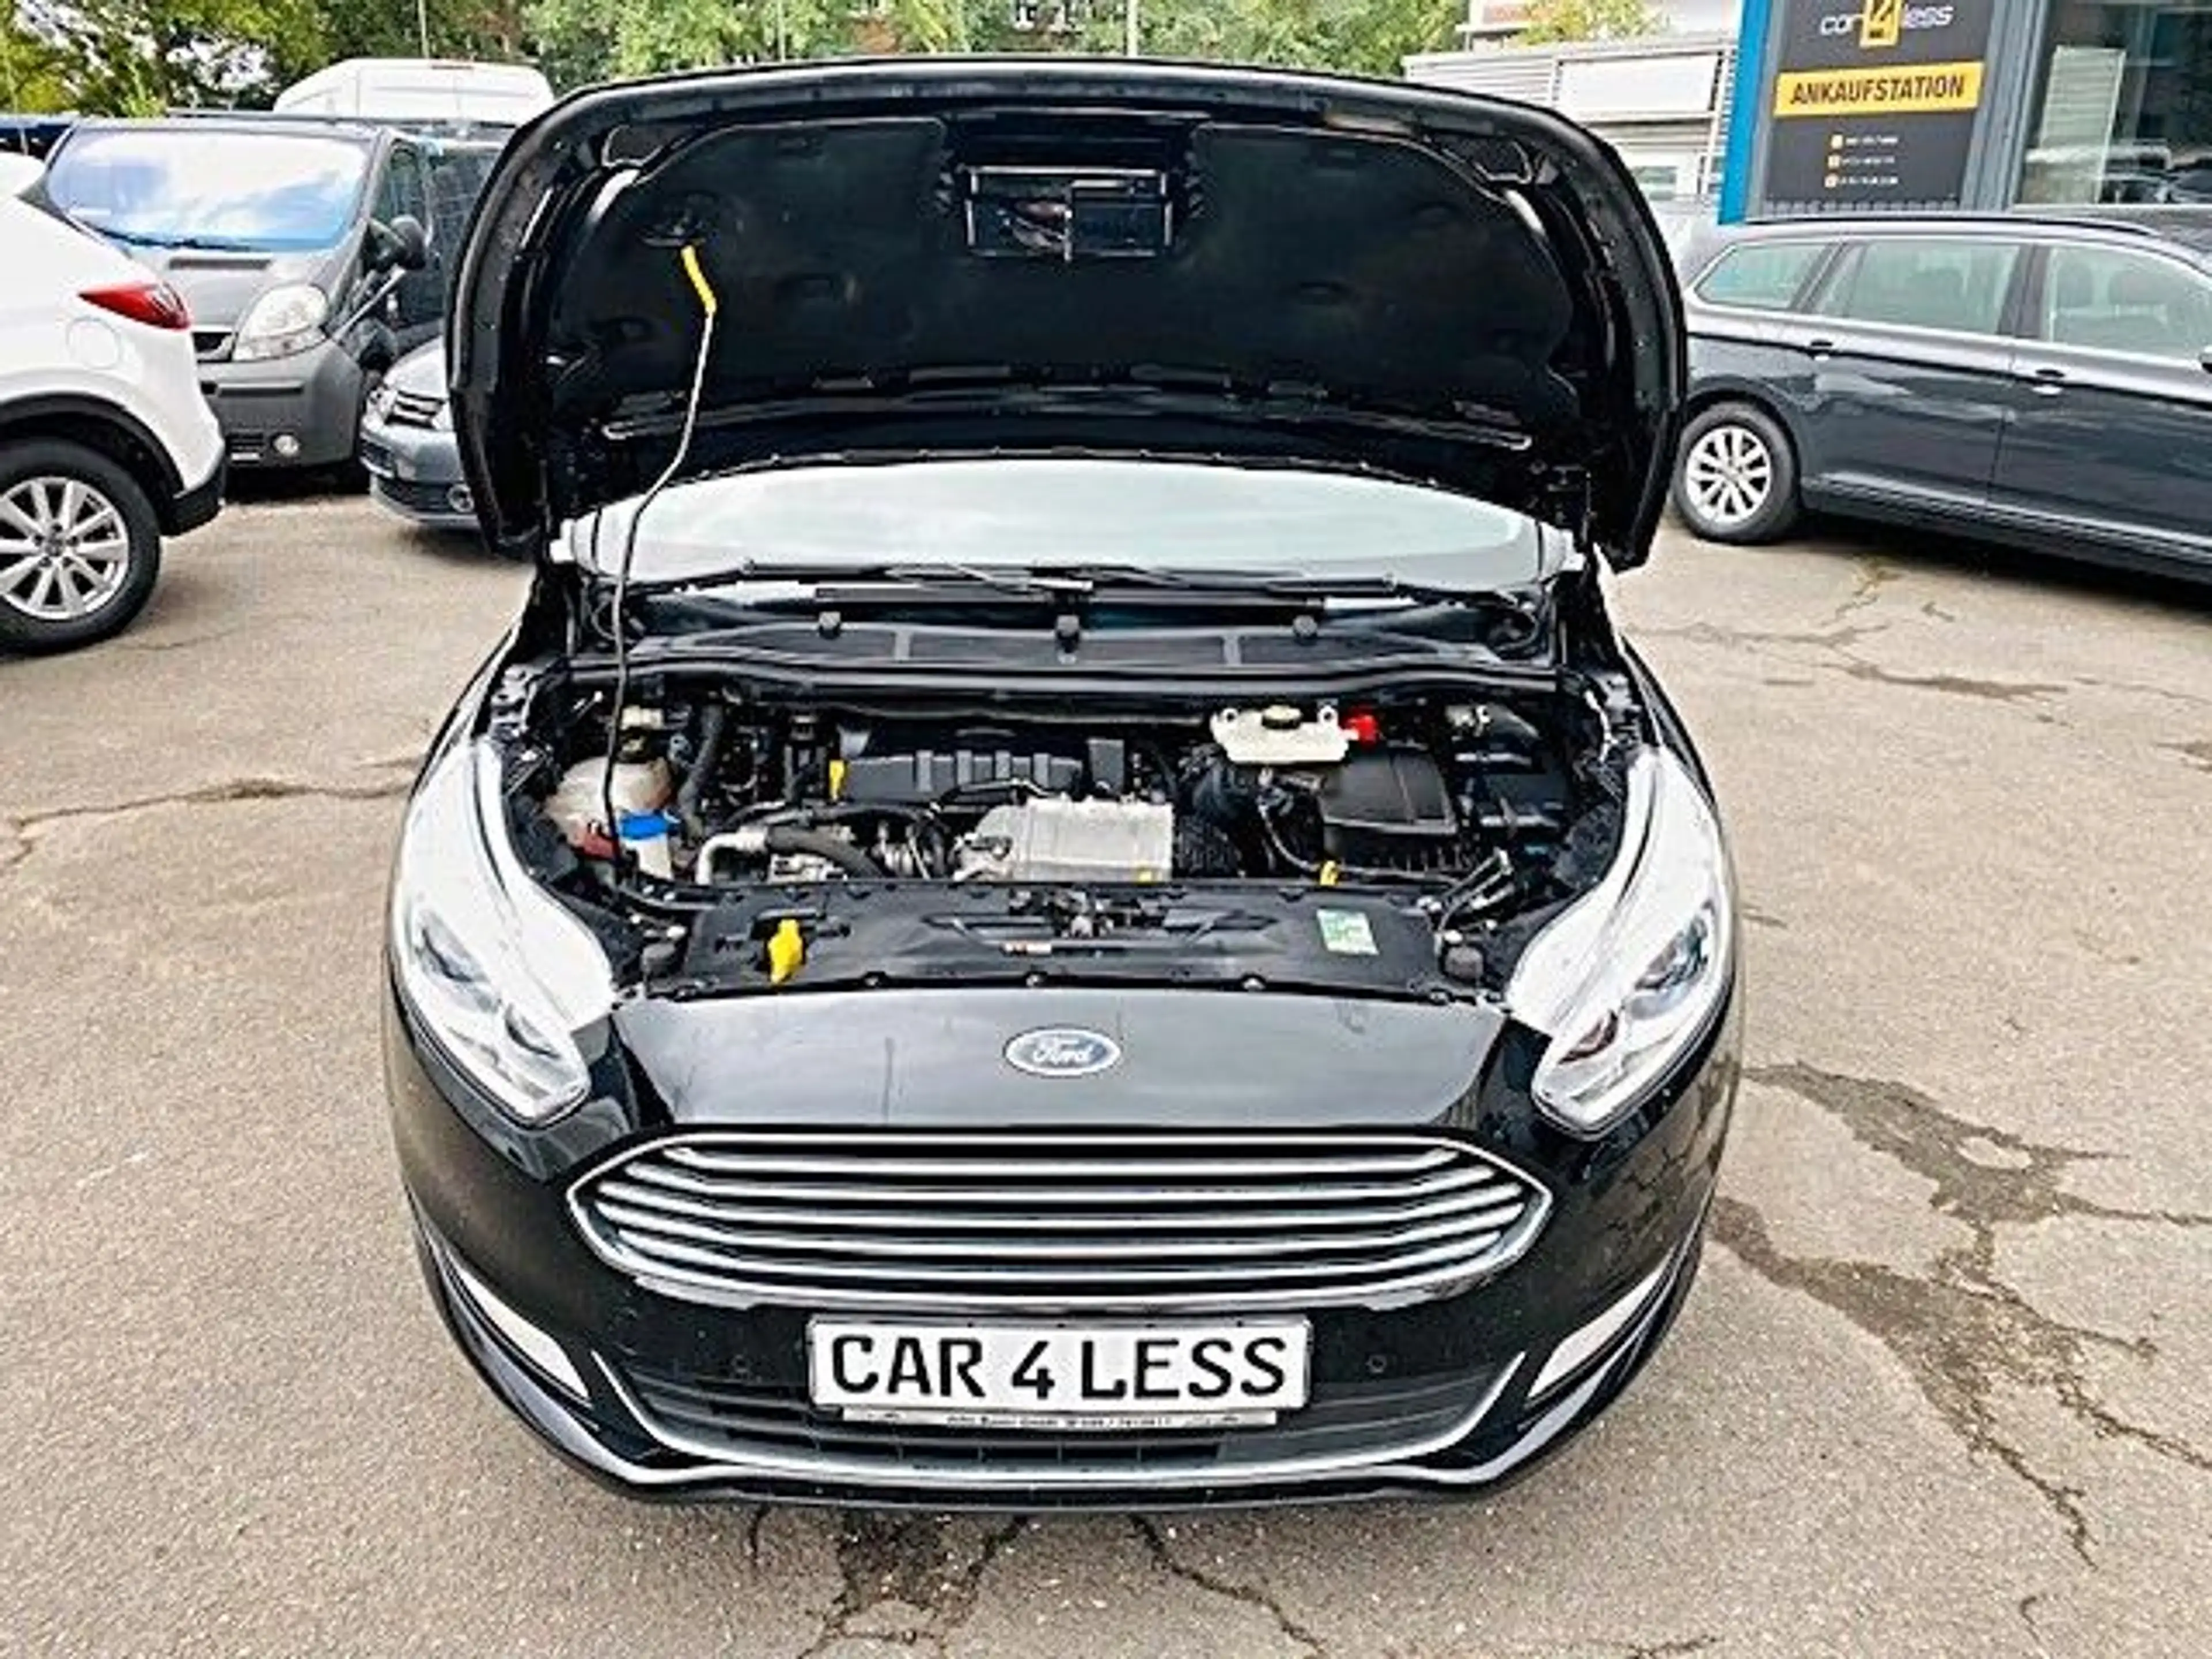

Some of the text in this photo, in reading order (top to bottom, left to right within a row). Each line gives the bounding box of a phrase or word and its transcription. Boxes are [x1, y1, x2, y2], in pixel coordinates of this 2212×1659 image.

[1821, 13, 1864, 35] car
[1903, 4, 1953, 28] less
[1790, 74, 1965, 105] ANKAUFSTATION
[1027, 1036, 1096, 1066] Ford
[831, 1334, 1287, 1400] CAR 4 LESS
